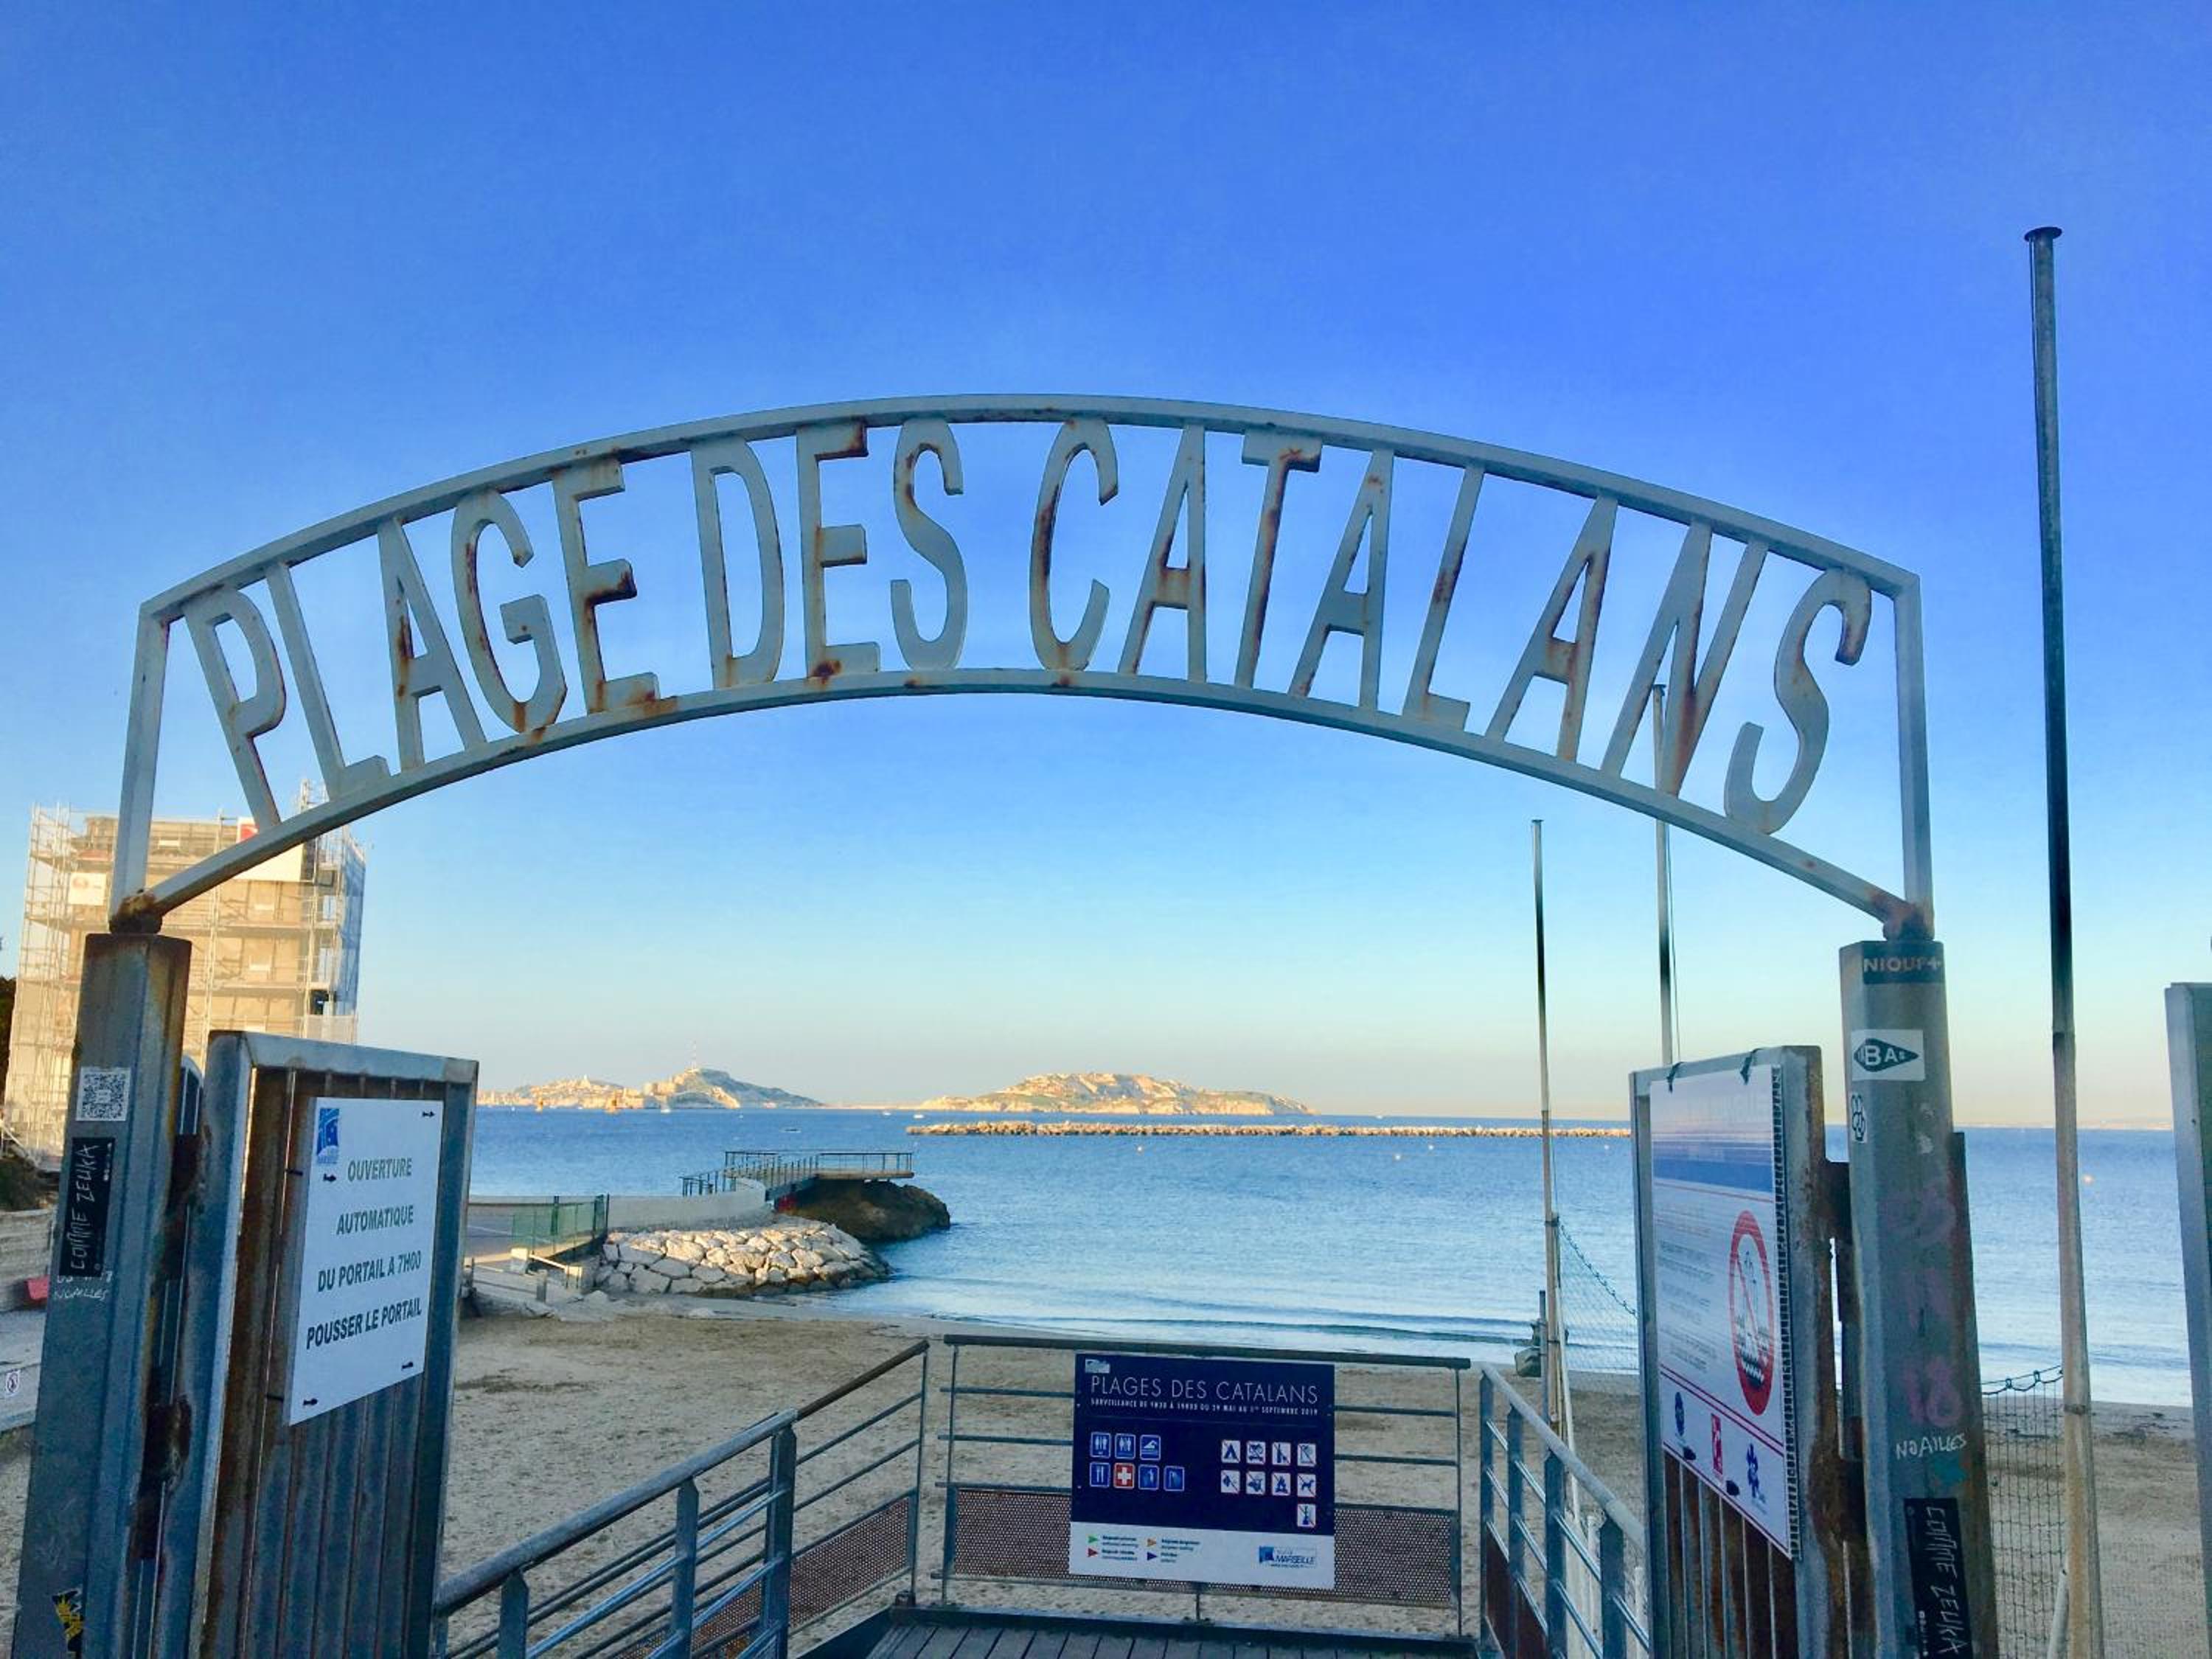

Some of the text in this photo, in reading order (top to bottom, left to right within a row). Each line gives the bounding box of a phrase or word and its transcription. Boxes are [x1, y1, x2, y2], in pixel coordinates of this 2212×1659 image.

[181, 417, 1871, 835] PLAGE DES CATALANS
[347, 1158, 412, 1181] OUVERTURE
[337, 1206, 414, 1235] AUTOMATIQUE
[318, 1267, 335, 1292] DU
[338, 1258, 386, 1287] PORTAIL
[397, 1250, 421, 1273] 7H00
[306, 1297, 422, 1349] POUSSER LE PORTAIL
[1091, 1375, 1318, 1405] PLAGES DES CATALANS
